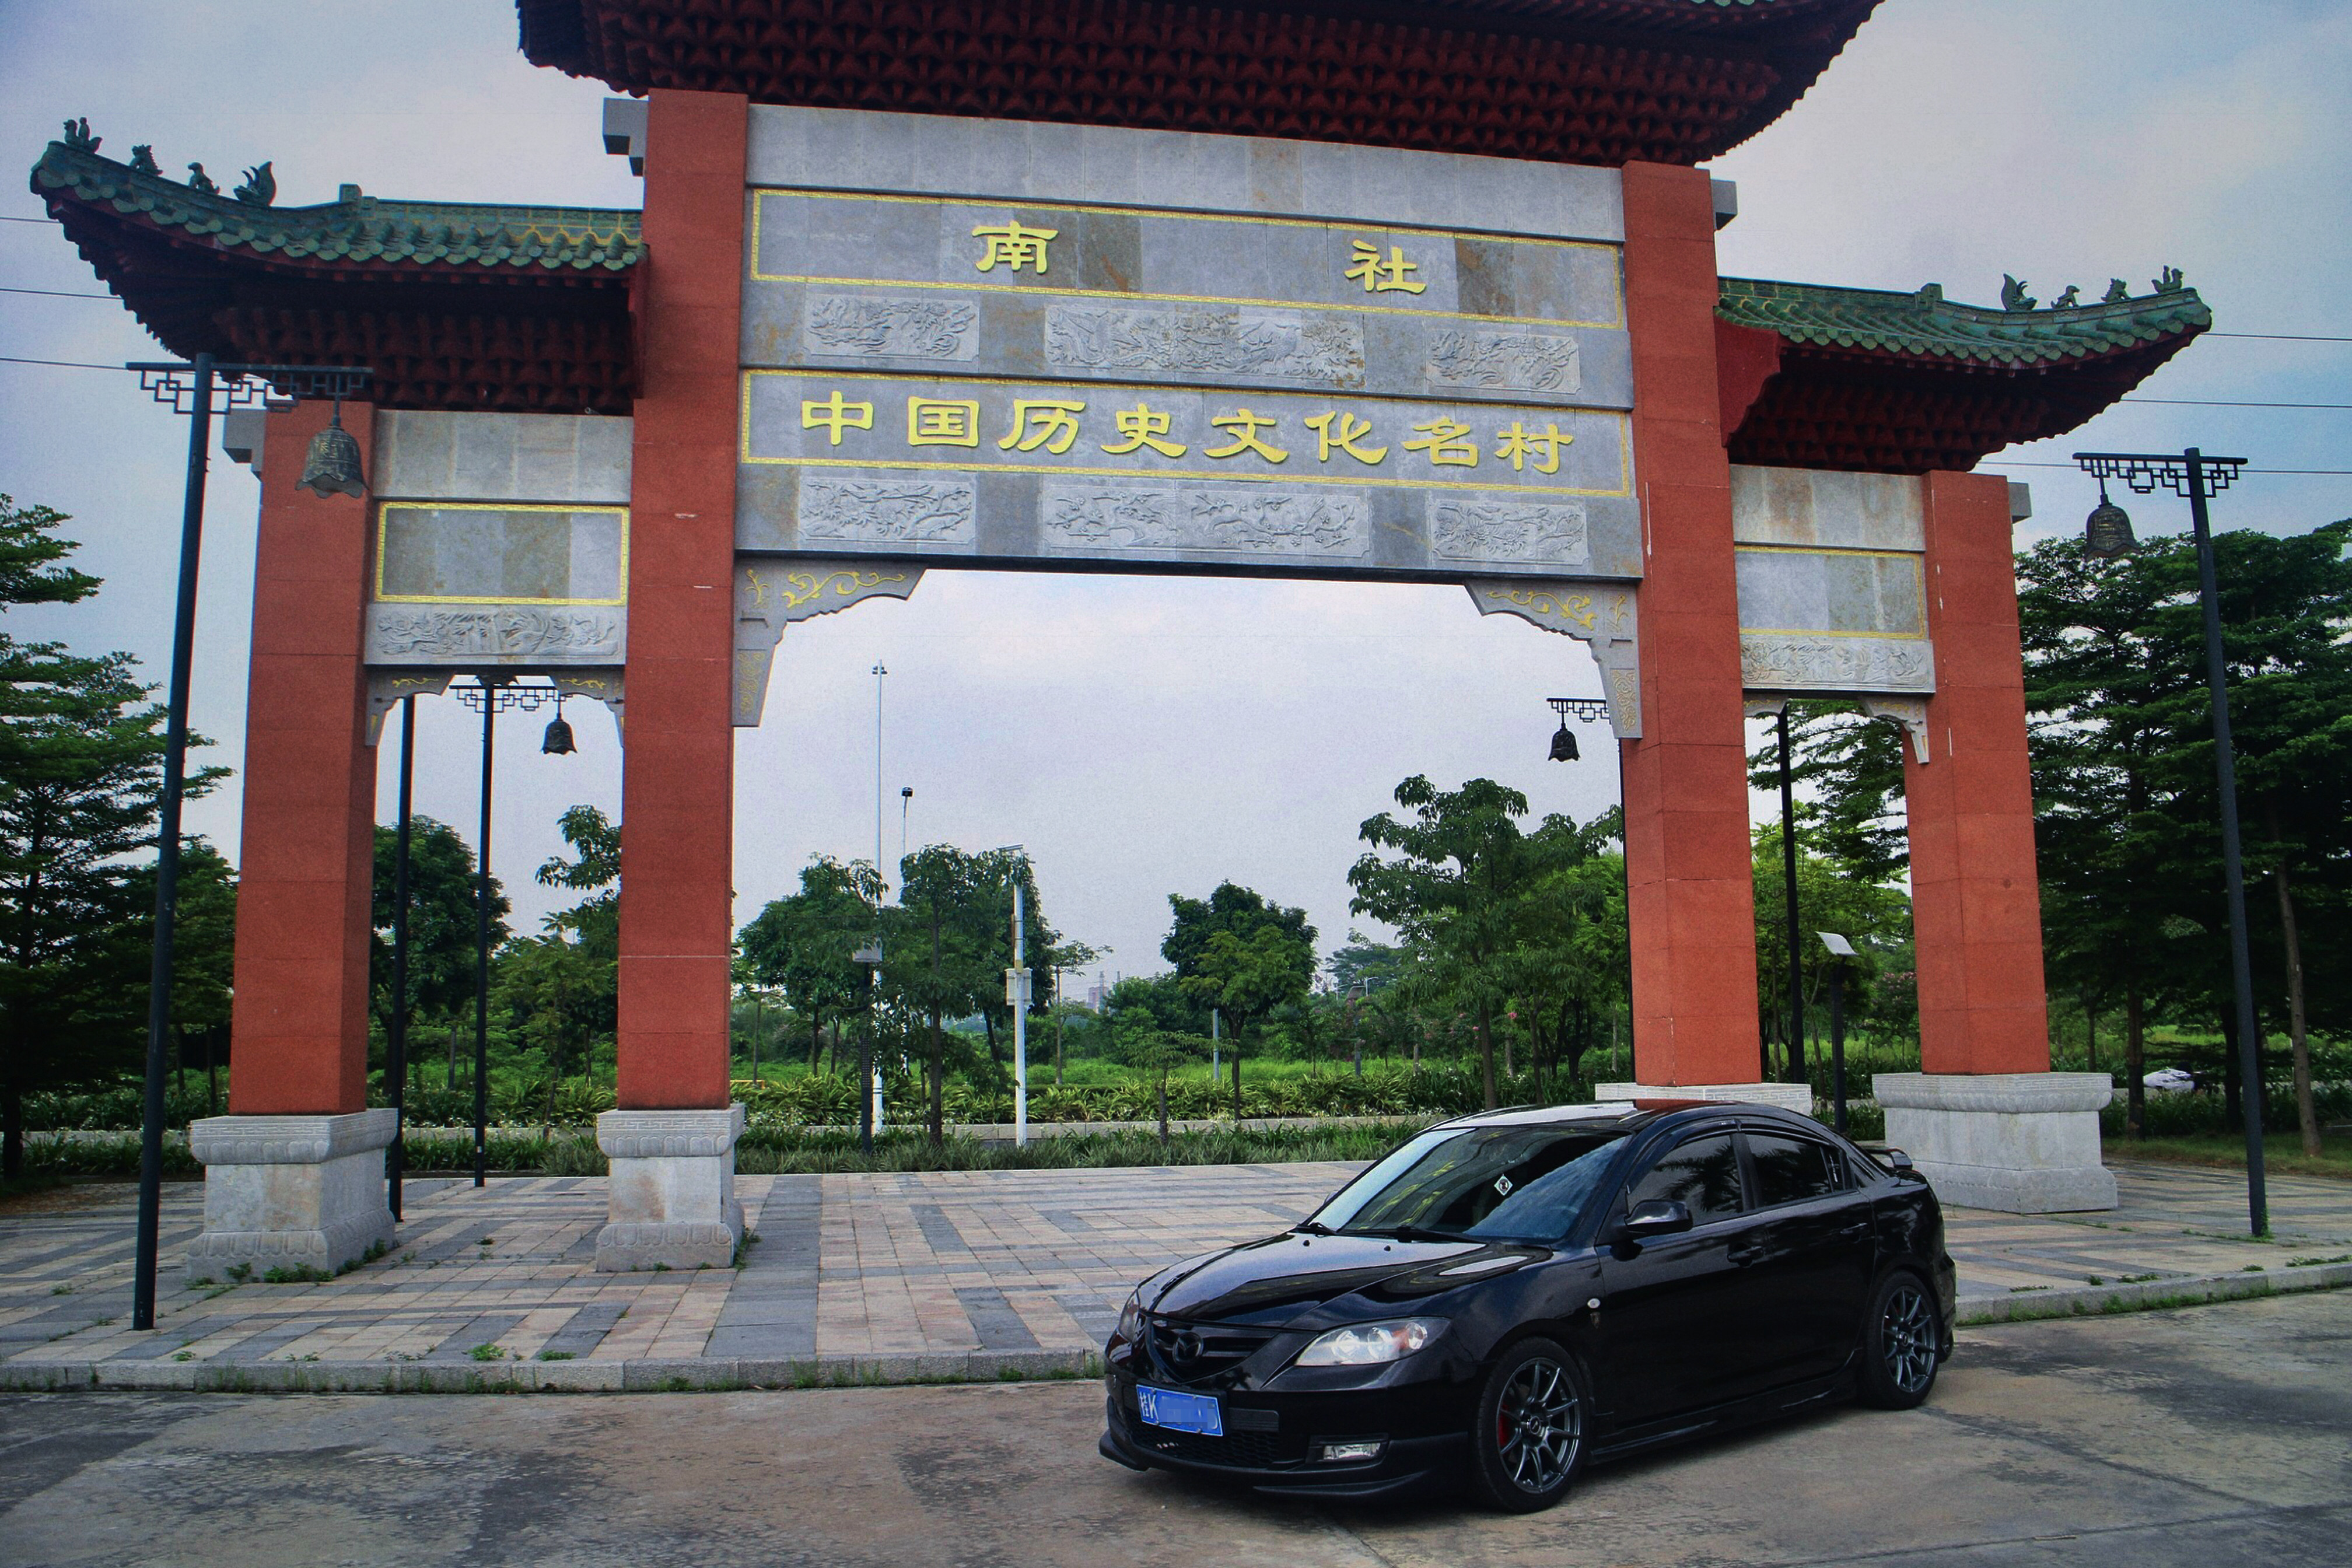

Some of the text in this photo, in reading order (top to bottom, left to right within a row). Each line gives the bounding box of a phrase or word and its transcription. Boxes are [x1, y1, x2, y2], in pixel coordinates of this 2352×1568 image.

[972, 220, 1426, 294] 南 社
[800, 390, 1574, 474] 中国历史文化名村
